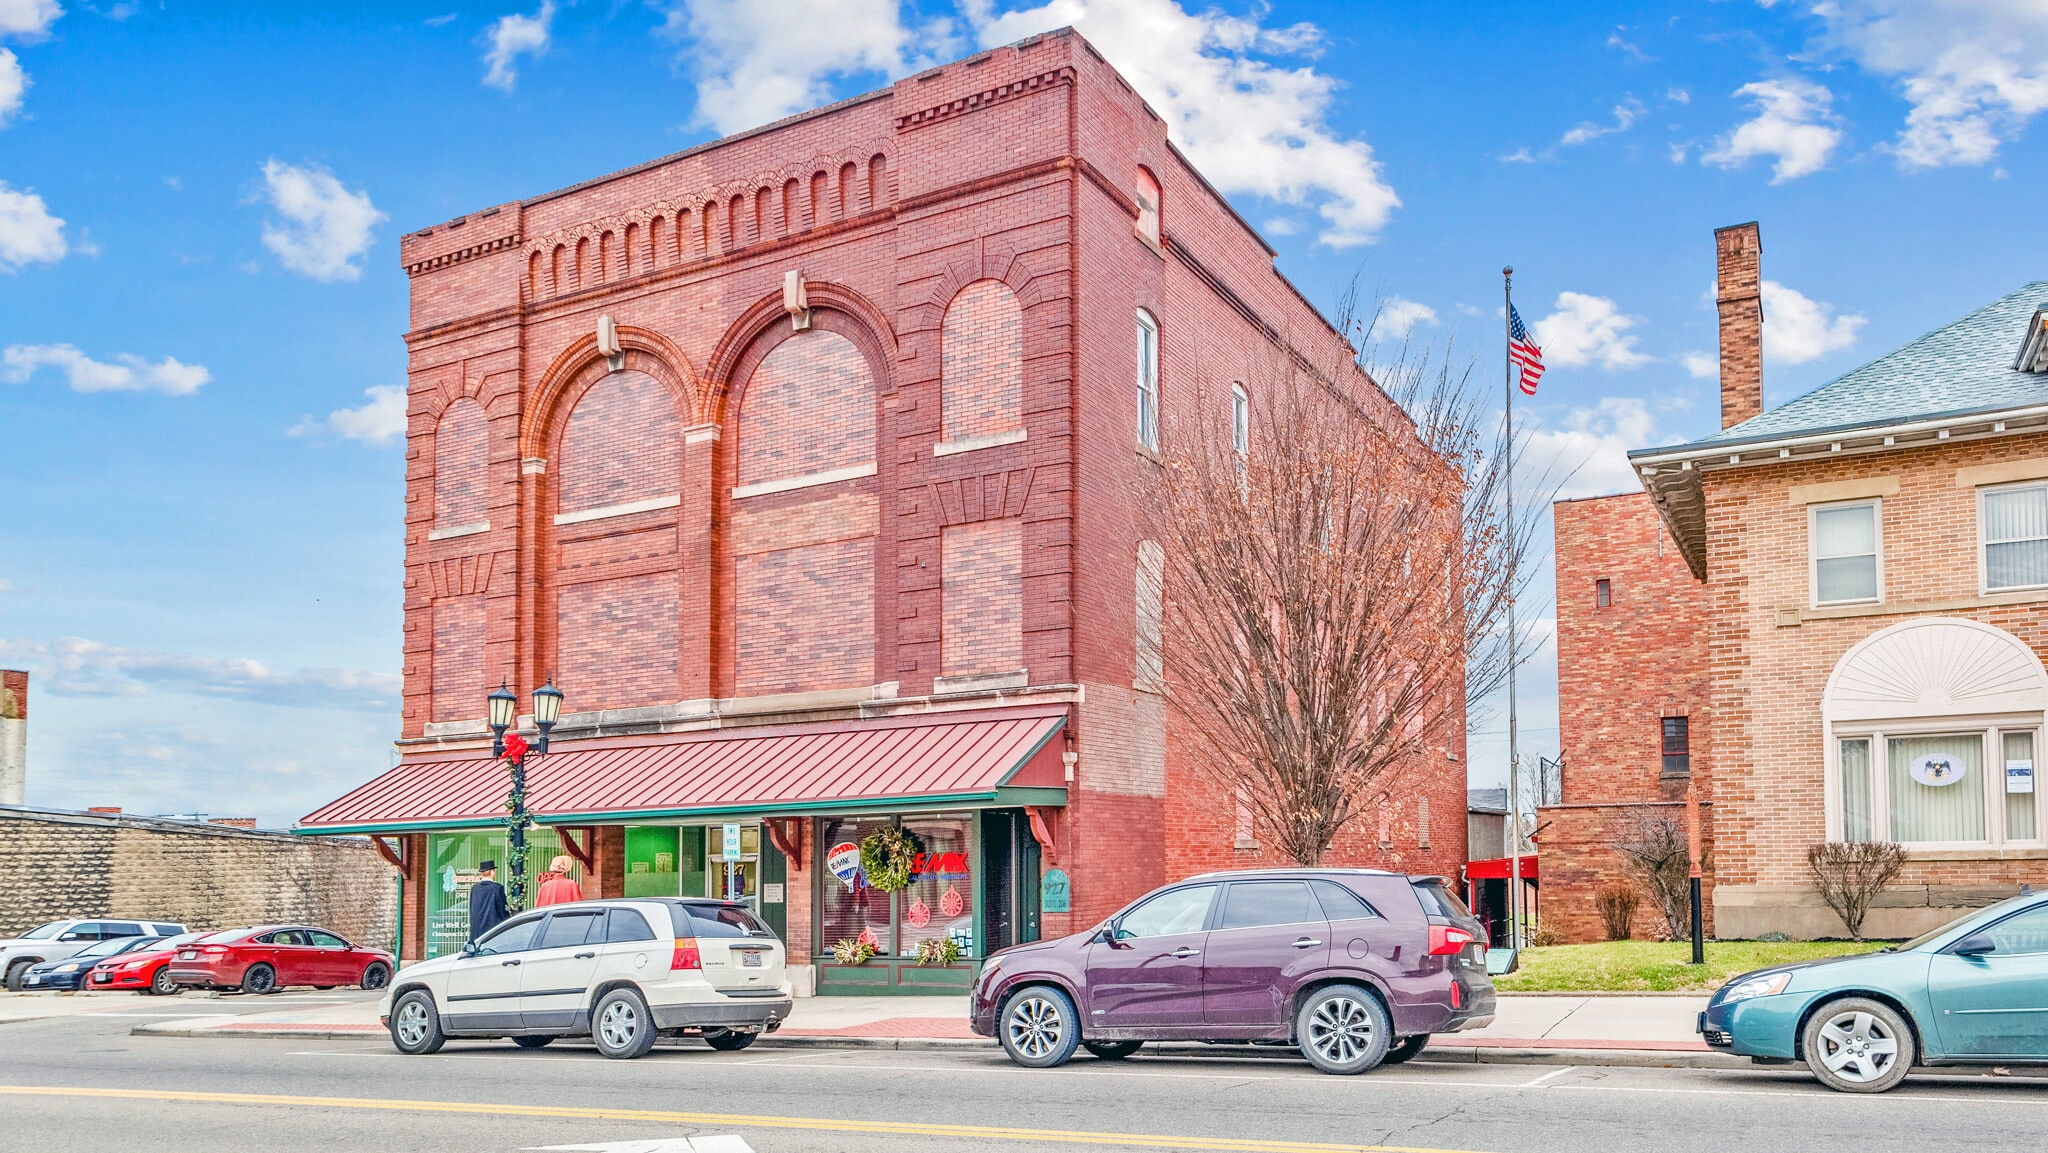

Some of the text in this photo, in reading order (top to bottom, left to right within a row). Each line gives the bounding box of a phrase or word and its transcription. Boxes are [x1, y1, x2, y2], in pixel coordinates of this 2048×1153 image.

[727, 838, 737, 846] HOUR
[830, 856, 850, 870] RE/MAX
[723, 864, 745, 876] 927
[537, 871, 556, 884] OPE
[1044, 882, 1066, 896] 927
[1044, 899, 1067, 909] SUITE 206
[432, 931, 465, 939] Chiropractic
